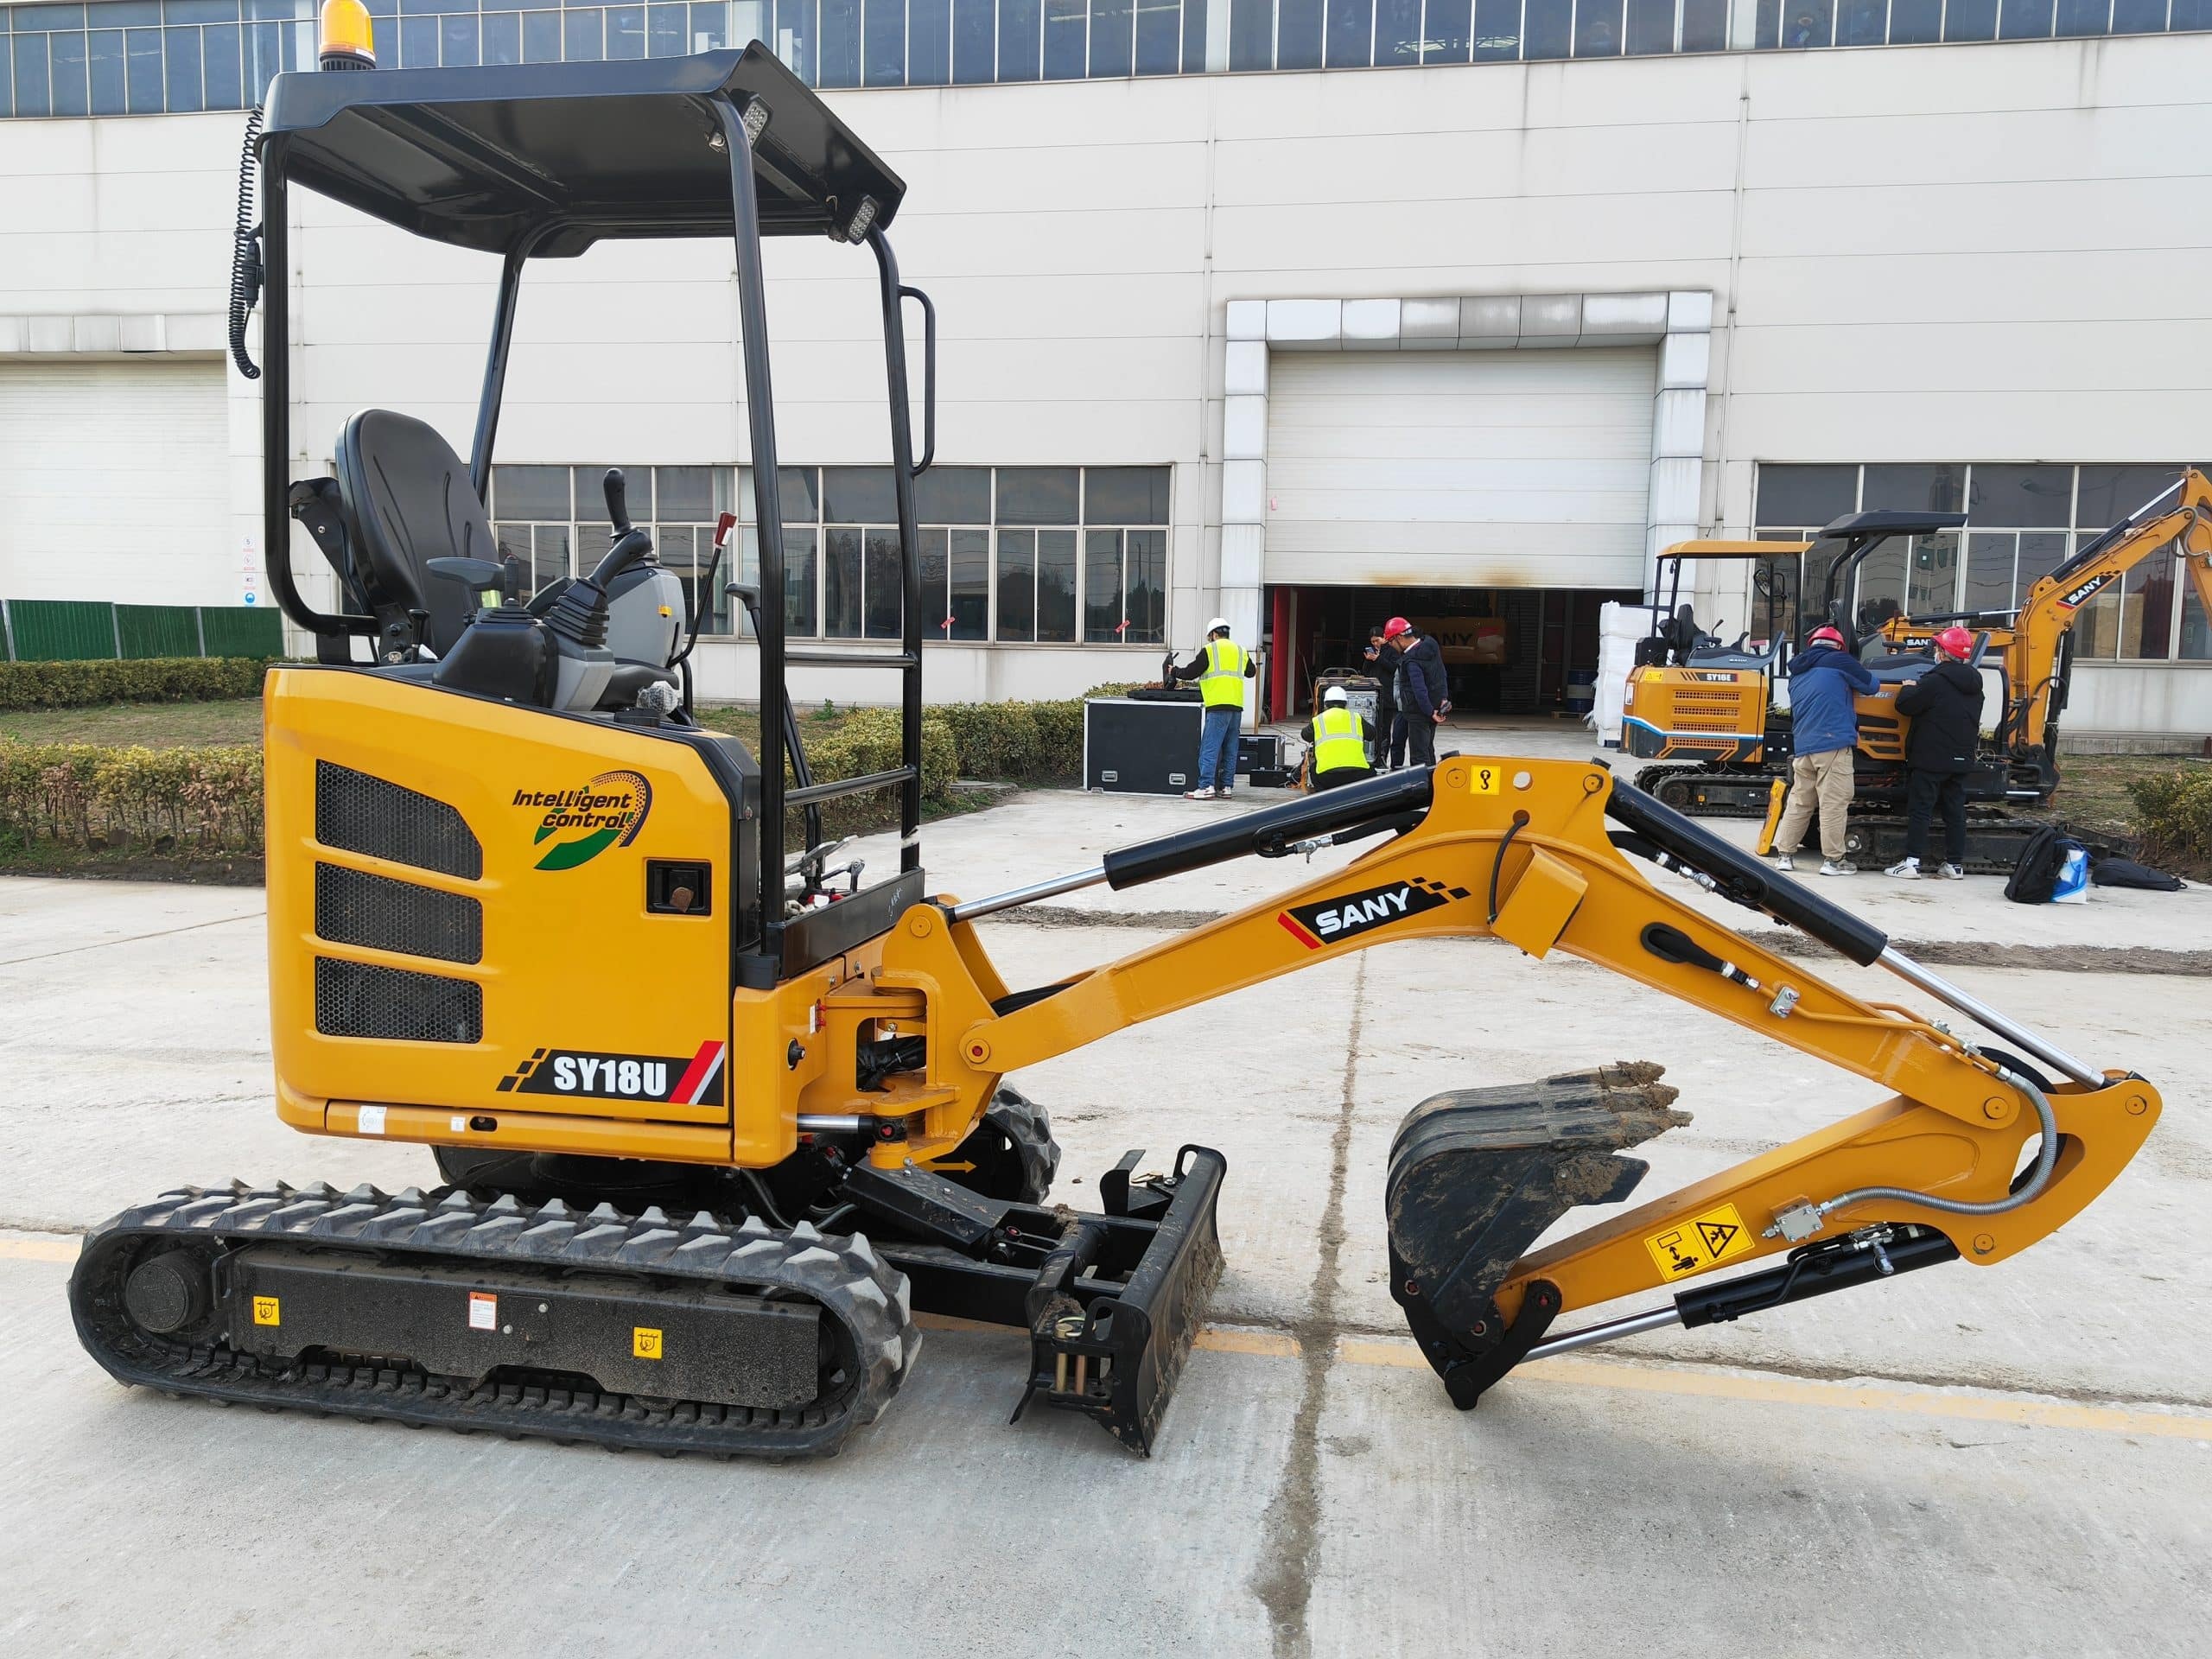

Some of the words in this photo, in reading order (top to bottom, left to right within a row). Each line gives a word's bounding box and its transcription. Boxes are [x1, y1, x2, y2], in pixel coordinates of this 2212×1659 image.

[2069, 576, 2102, 604] SANY
[1707, 673, 1732, 682] SY16E
[512, 788, 632, 812] Intelligent
[543, 810, 628, 829] control
[1315, 886, 1411, 936] SANY
[554, 1055, 667, 1096] SY18U
